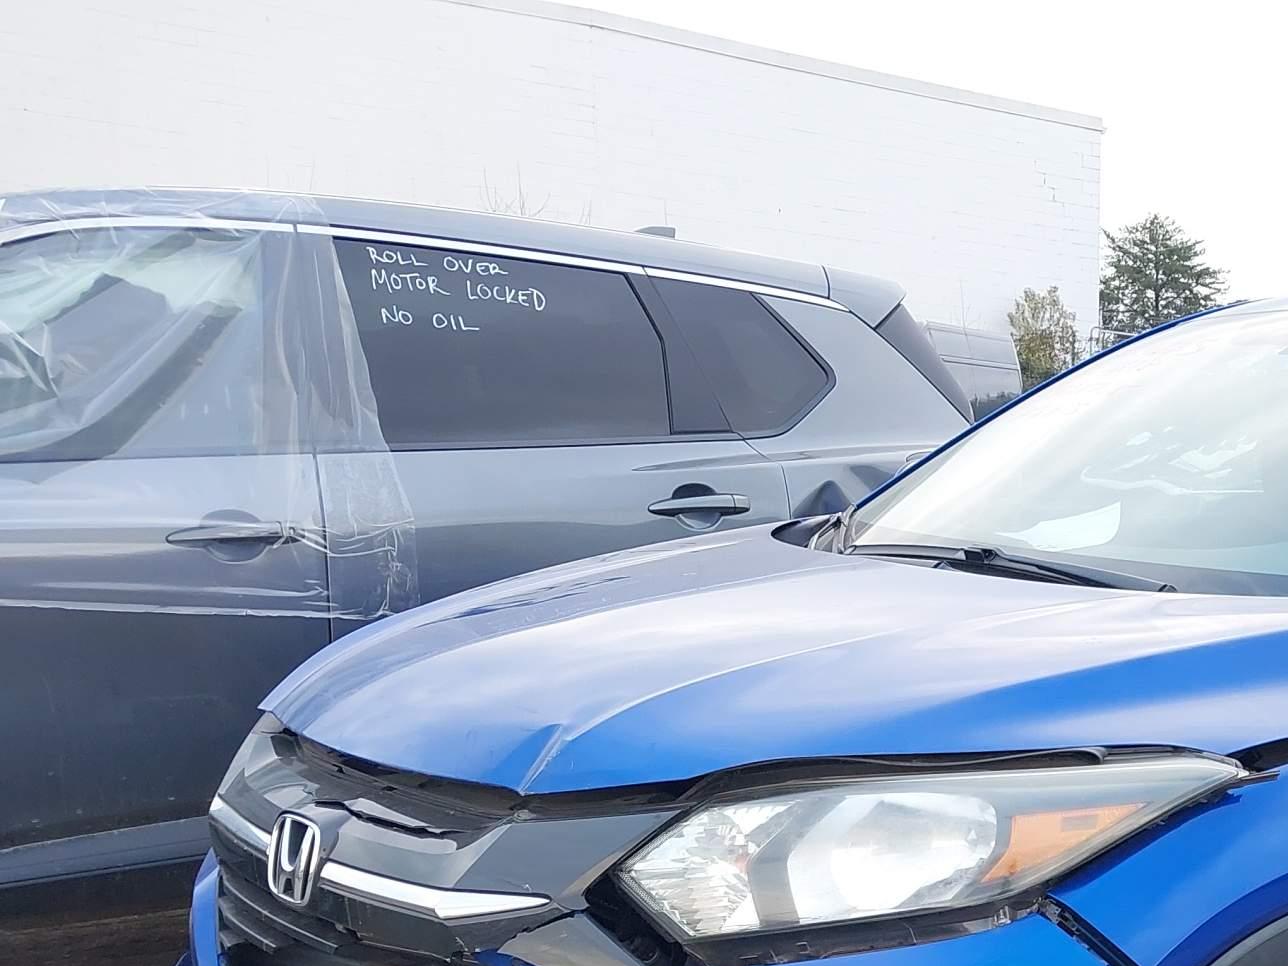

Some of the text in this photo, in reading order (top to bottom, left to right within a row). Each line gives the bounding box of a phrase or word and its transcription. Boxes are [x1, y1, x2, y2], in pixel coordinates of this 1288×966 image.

[366, 246, 509, 275] ROLL OVER
[371, 268, 546, 311] MOTOR LOCKED
[380, 305, 480, 331] NO OIL
